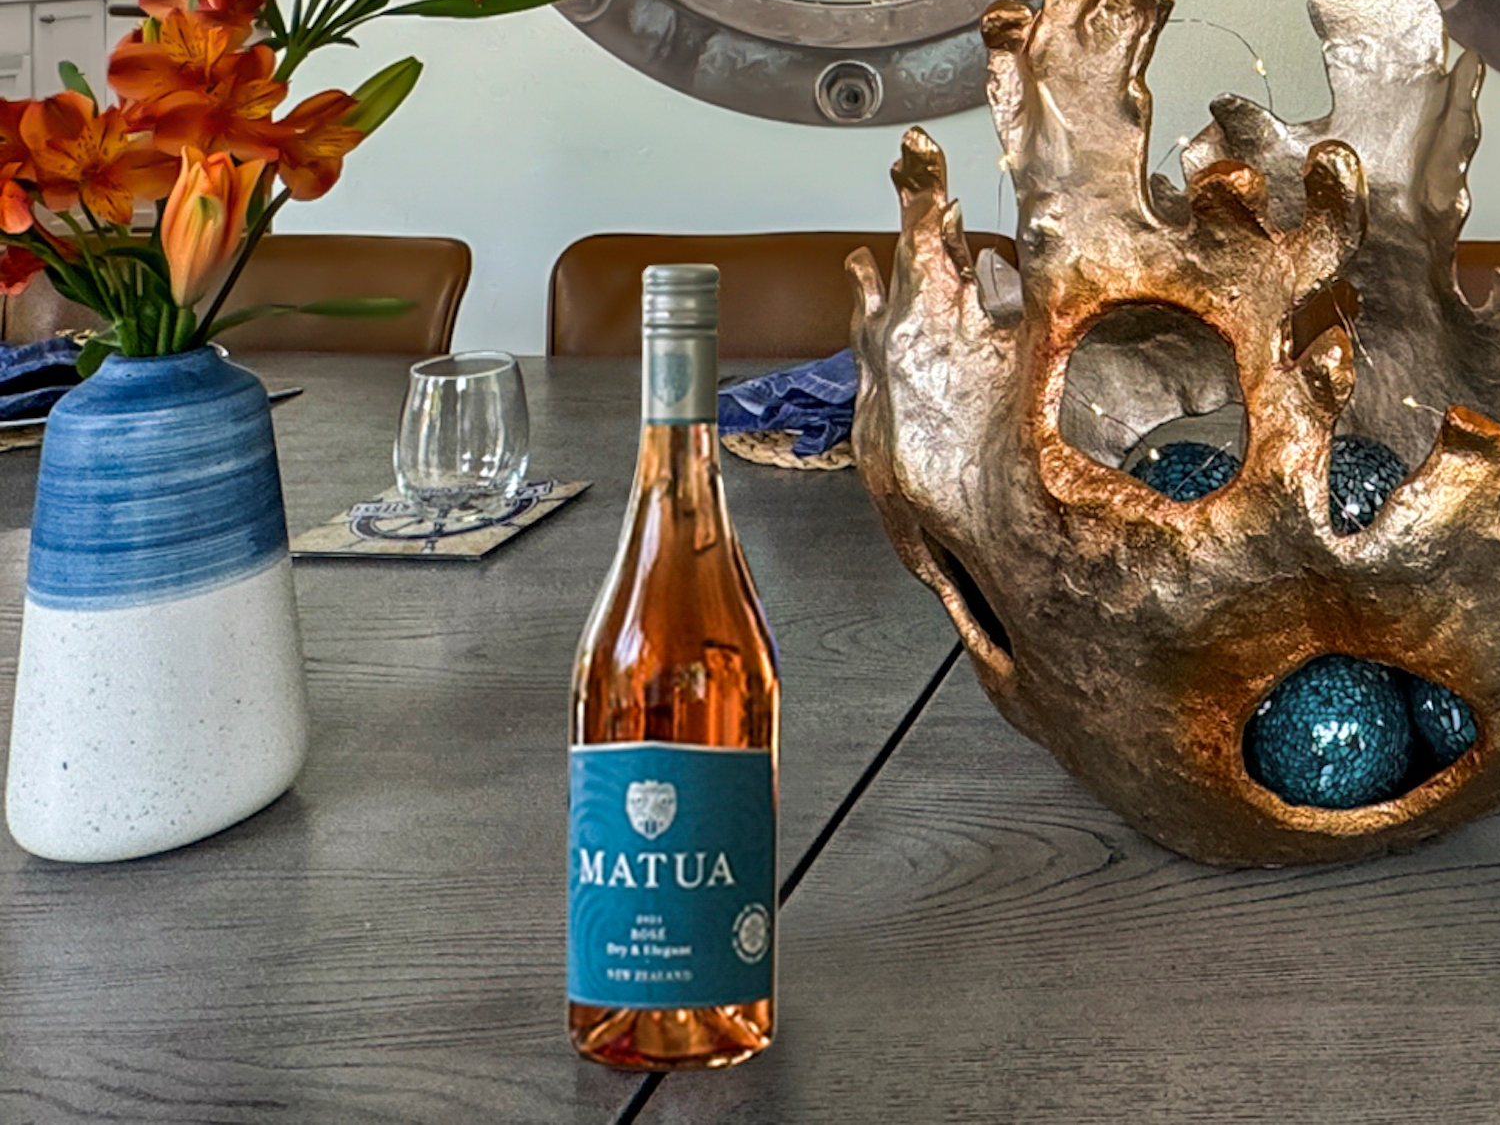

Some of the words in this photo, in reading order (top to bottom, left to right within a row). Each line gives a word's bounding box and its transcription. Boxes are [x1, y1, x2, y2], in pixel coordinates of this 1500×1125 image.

[579, 848, 735, 888] MATUA
[607, 942, 628, 959] Dry
[631, 944, 640, 956] &
[643, 944, 692, 959] Elegant
[607, 968, 631, 982] NEW
[634, 969, 694, 982] ZEALAND
